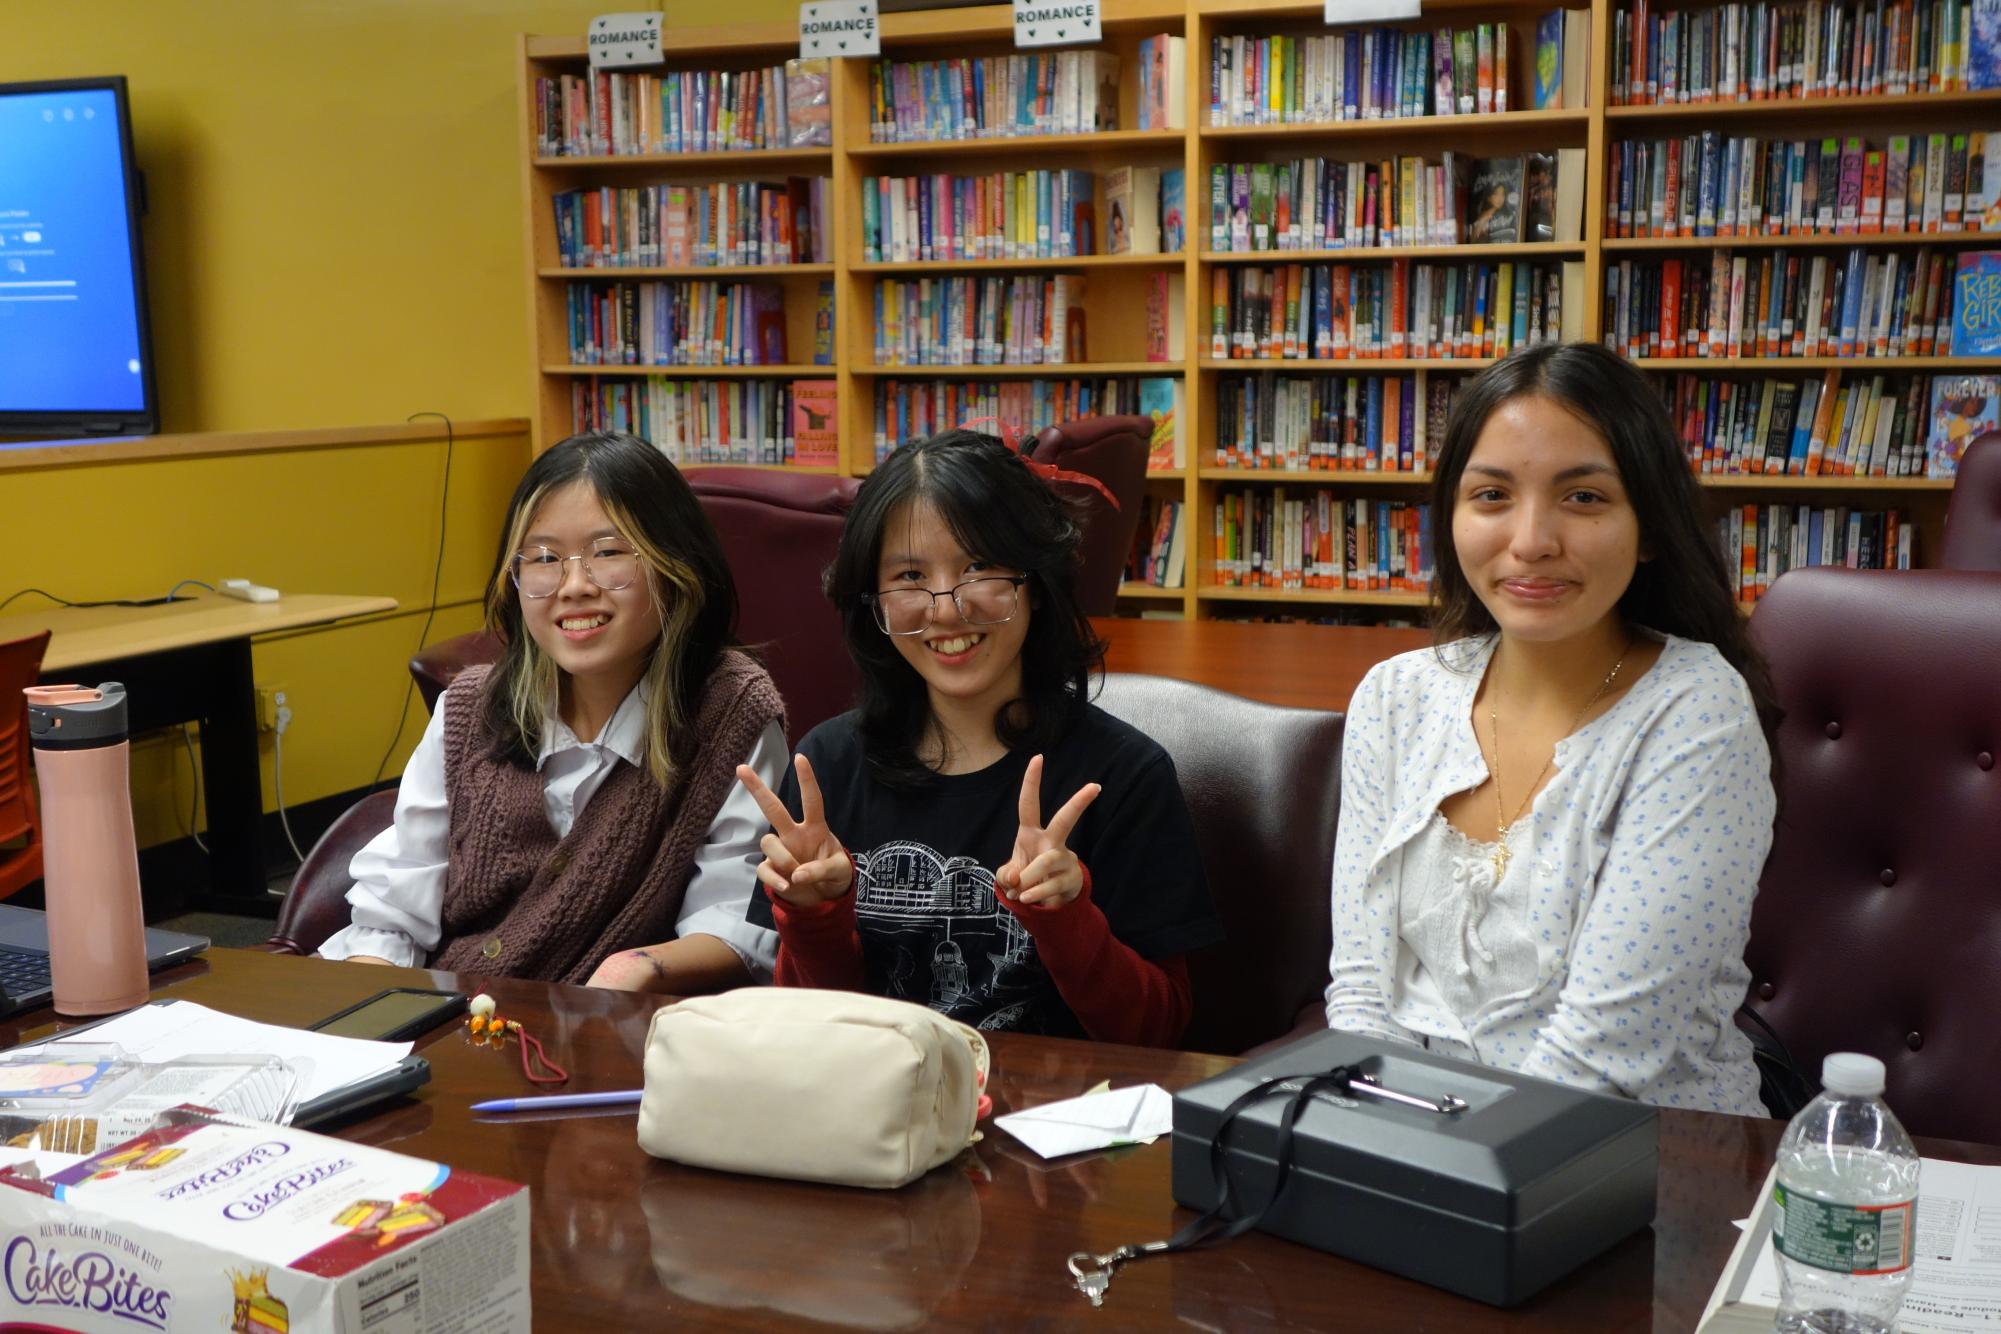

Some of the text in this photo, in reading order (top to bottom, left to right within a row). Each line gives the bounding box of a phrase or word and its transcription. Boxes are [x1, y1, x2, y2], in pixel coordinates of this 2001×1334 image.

[1016, 5, 1095, 24] ROMANCE
[801, 17, 875, 36] ROMANCE
[589, 29, 658, 46] ROMANCE
[1840, 153, 1862, 217] GLAS
[1936, 378, 1996, 399] FOREVER
[40, 1224, 53, 1239] ALL
[54, 1223, 66, 1237] THE
[69, 1222, 88, 1238] CAKE
[91, 1227, 102, 1241] IN
[104, 1229, 122, 1247] JUST
[124, 1238, 141, 1256] ONE
[358, 1255, 417, 1289] Nutrition Facts
